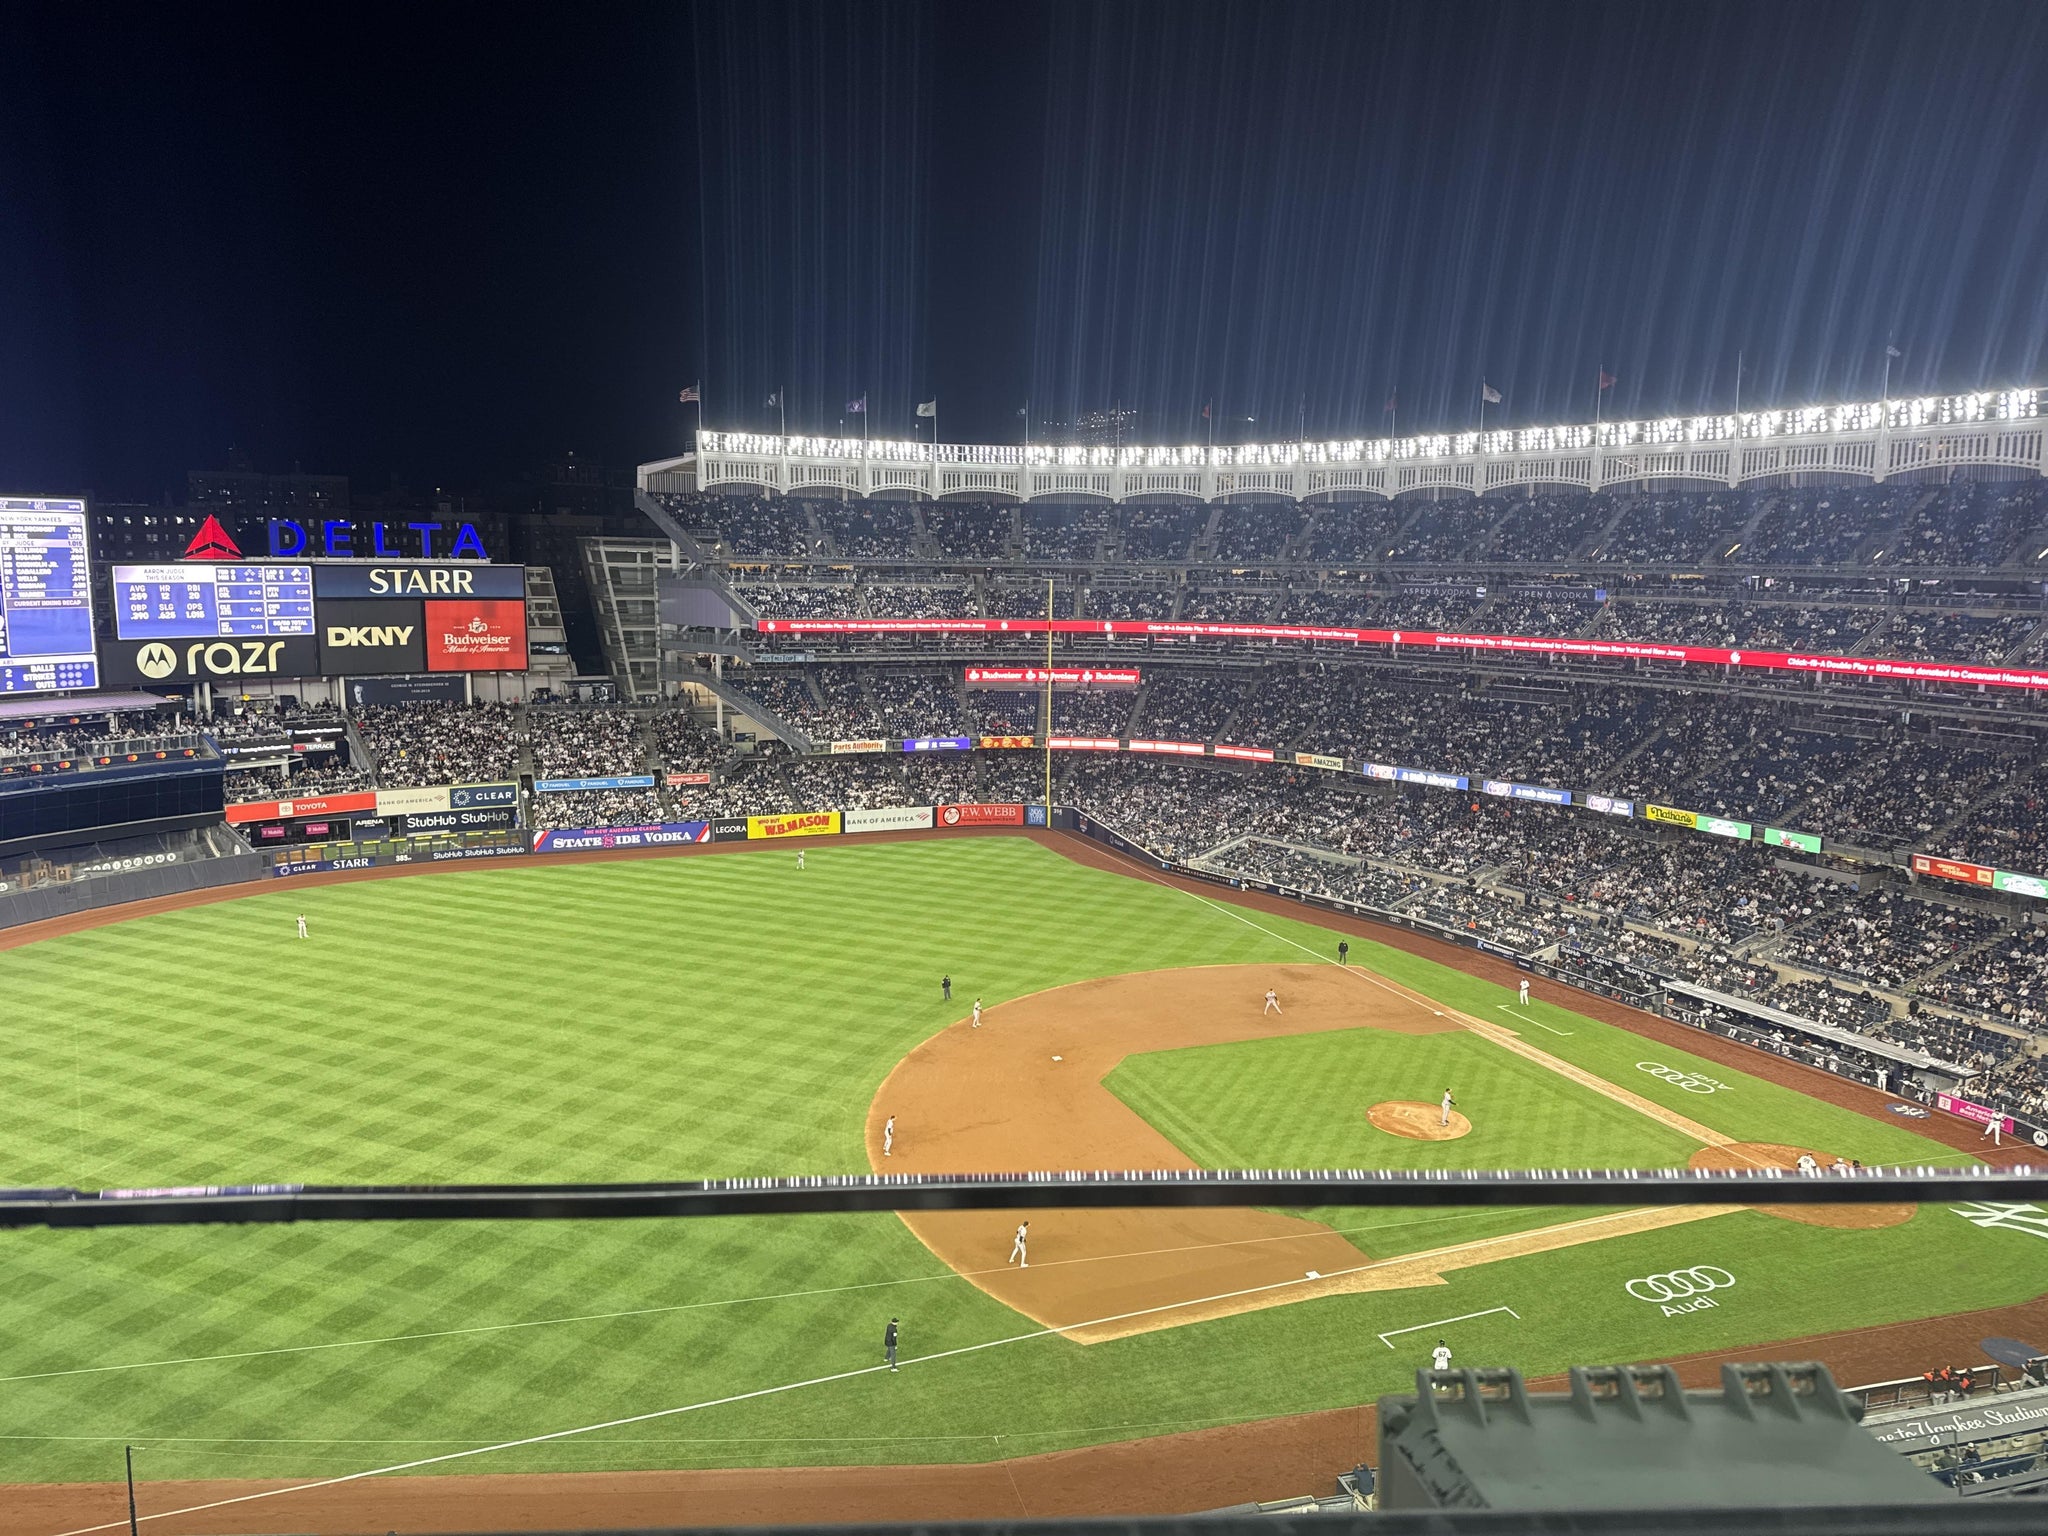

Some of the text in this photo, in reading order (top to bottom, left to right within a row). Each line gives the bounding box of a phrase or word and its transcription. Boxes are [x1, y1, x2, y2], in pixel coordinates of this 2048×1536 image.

[270, 521, 488, 558] DELTA
[369, 569, 474, 595] STARR
[188, 592, 200, 600] 20
[1442, 588, 1471, 596] VODKA
[1518, 590, 1588, 600] SPEN VODKA
[186, 611, 205, 619] 1.015
[327, 626, 414, 648] DKNY
[444, 634, 510, 644] Budweiser
[443, 645, 468, 653] Made
[469, 646, 477, 654] of
[1667, 649, 1686, 658] Jersey
[186, 640, 285, 674] razr
[5, 664, 55, 677] 2 BALLS
[1788, 658, 1825, 667] Chick-fil-A
[1827, 661, 1852, 669] Double
[1853, 662, 1868, 672] Play
[1892, 666, 1914, 674] meals
[1916, 667, 1949, 676] donated
[1961, 671, 2001, 680] Covenant
[2002, 674, 2030, 683] House
[23, 673, 56, 681] STRIKES
[1096, 672, 1136, 680] Budweiser
[6, 681, 56, 690] 2 OUTS
[306, 742, 334, 750] TERRACE
[853, 742, 882, 750] Authority
[1313, 758, 1341, 768] AMAZING
[1402, 772, 1458, 787] a sub above
[476, 792, 511, 800] CLEAR
[1522, 789, 1537, 797] sub
[1537, 790, 1562, 801] above
[296, 802, 327, 810] TOYOTA
[961, 807, 1016, 817] F.W. WEBB
[1651, 807, 1691, 824] Nathan's
[407, 811, 509, 828] StubHub StubHub
[553, 831, 691, 848] STATESIDE VODKA
[395, 854, 408, 862] 385
[434, 851, 462, 859] StubHub
[496, 847, 524, 855] StubHub
[333, 858, 369, 869] STARR
[1561, 946, 1645, 976] StubHub StubHub StubHub
[1687, 1072, 1734, 1090] Audi
[1660, 1295, 1719, 1318] Audi
[1907, 1415, 1985, 1445] Yankee
